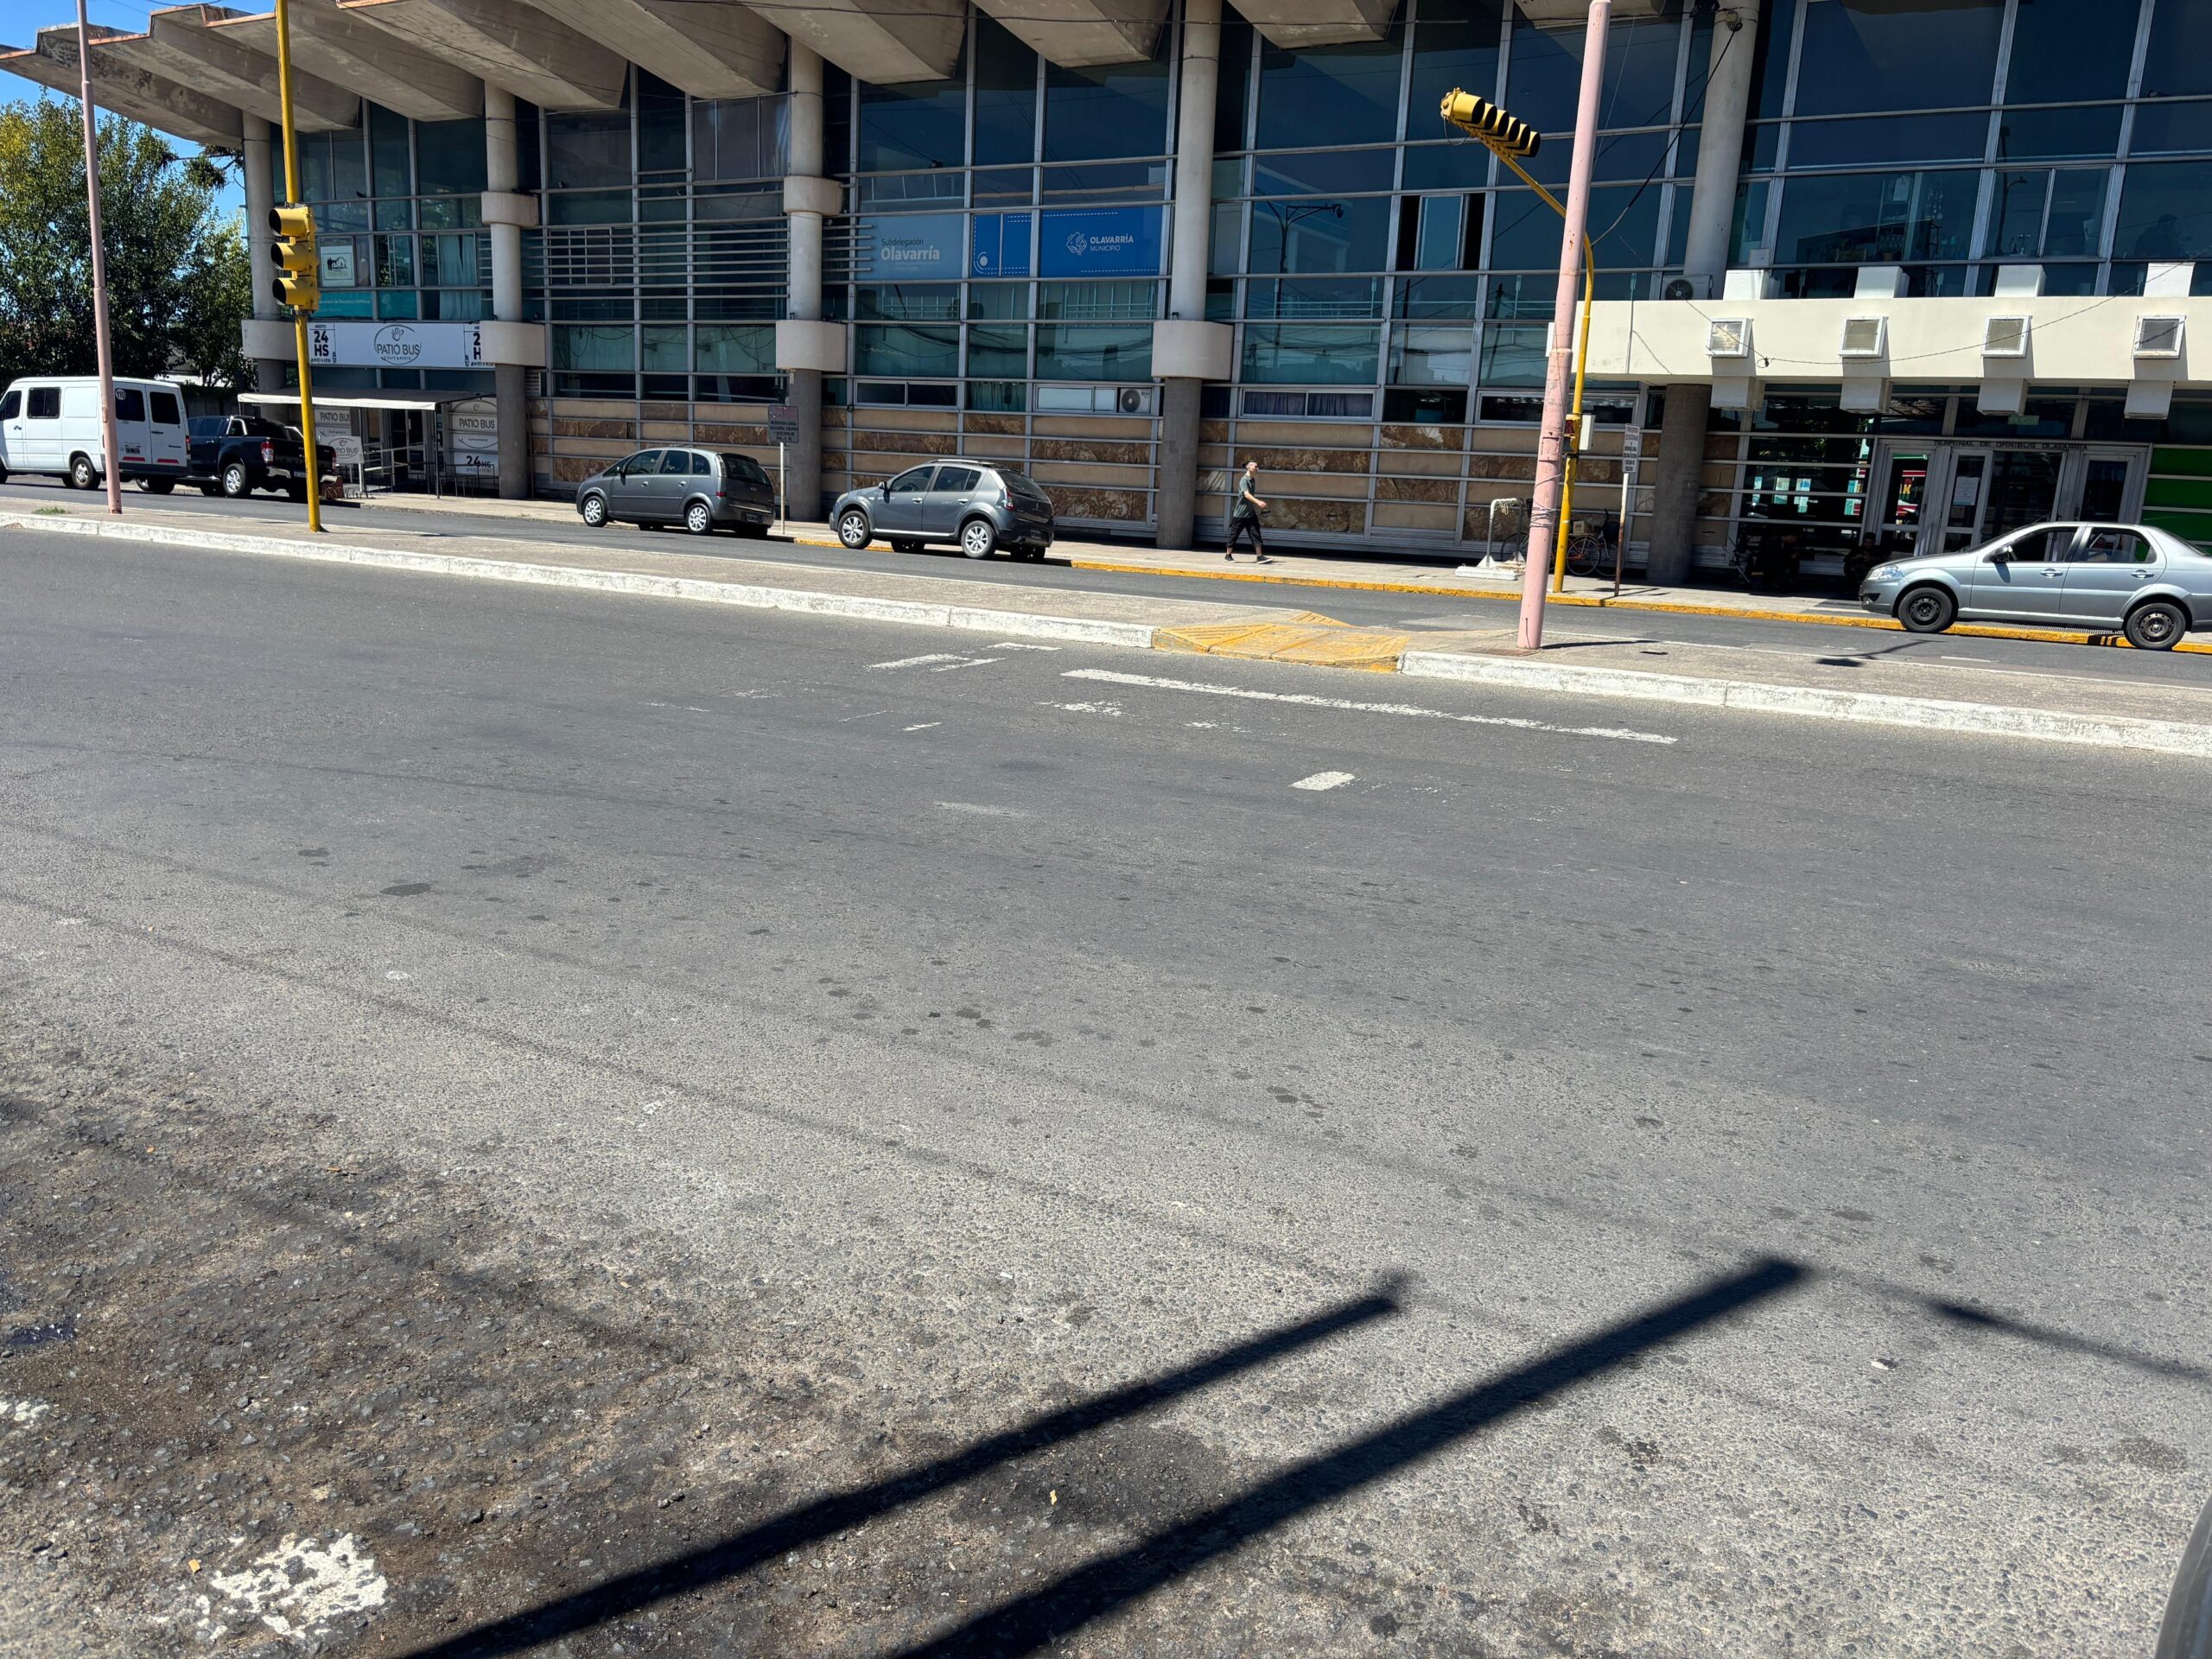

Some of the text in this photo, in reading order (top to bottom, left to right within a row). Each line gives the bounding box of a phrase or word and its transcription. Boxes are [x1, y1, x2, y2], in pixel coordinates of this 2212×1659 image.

[881, 238, 924, 248] Subdelegación
[1090, 233, 1134, 245] OLAVARRÍA
[880, 245, 940, 261] Olavarría
[314, 330, 329, 343] 24
[473, 332, 481, 346] 2
[315, 344, 329, 357] HS
[377, 343, 421, 356] PATIO BUS
[473, 346, 481, 360] H
[320, 411, 339, 422] PATIO
[459, 418, 495, 429] PATIO BUS
[467, 455, 480, 467] 24
